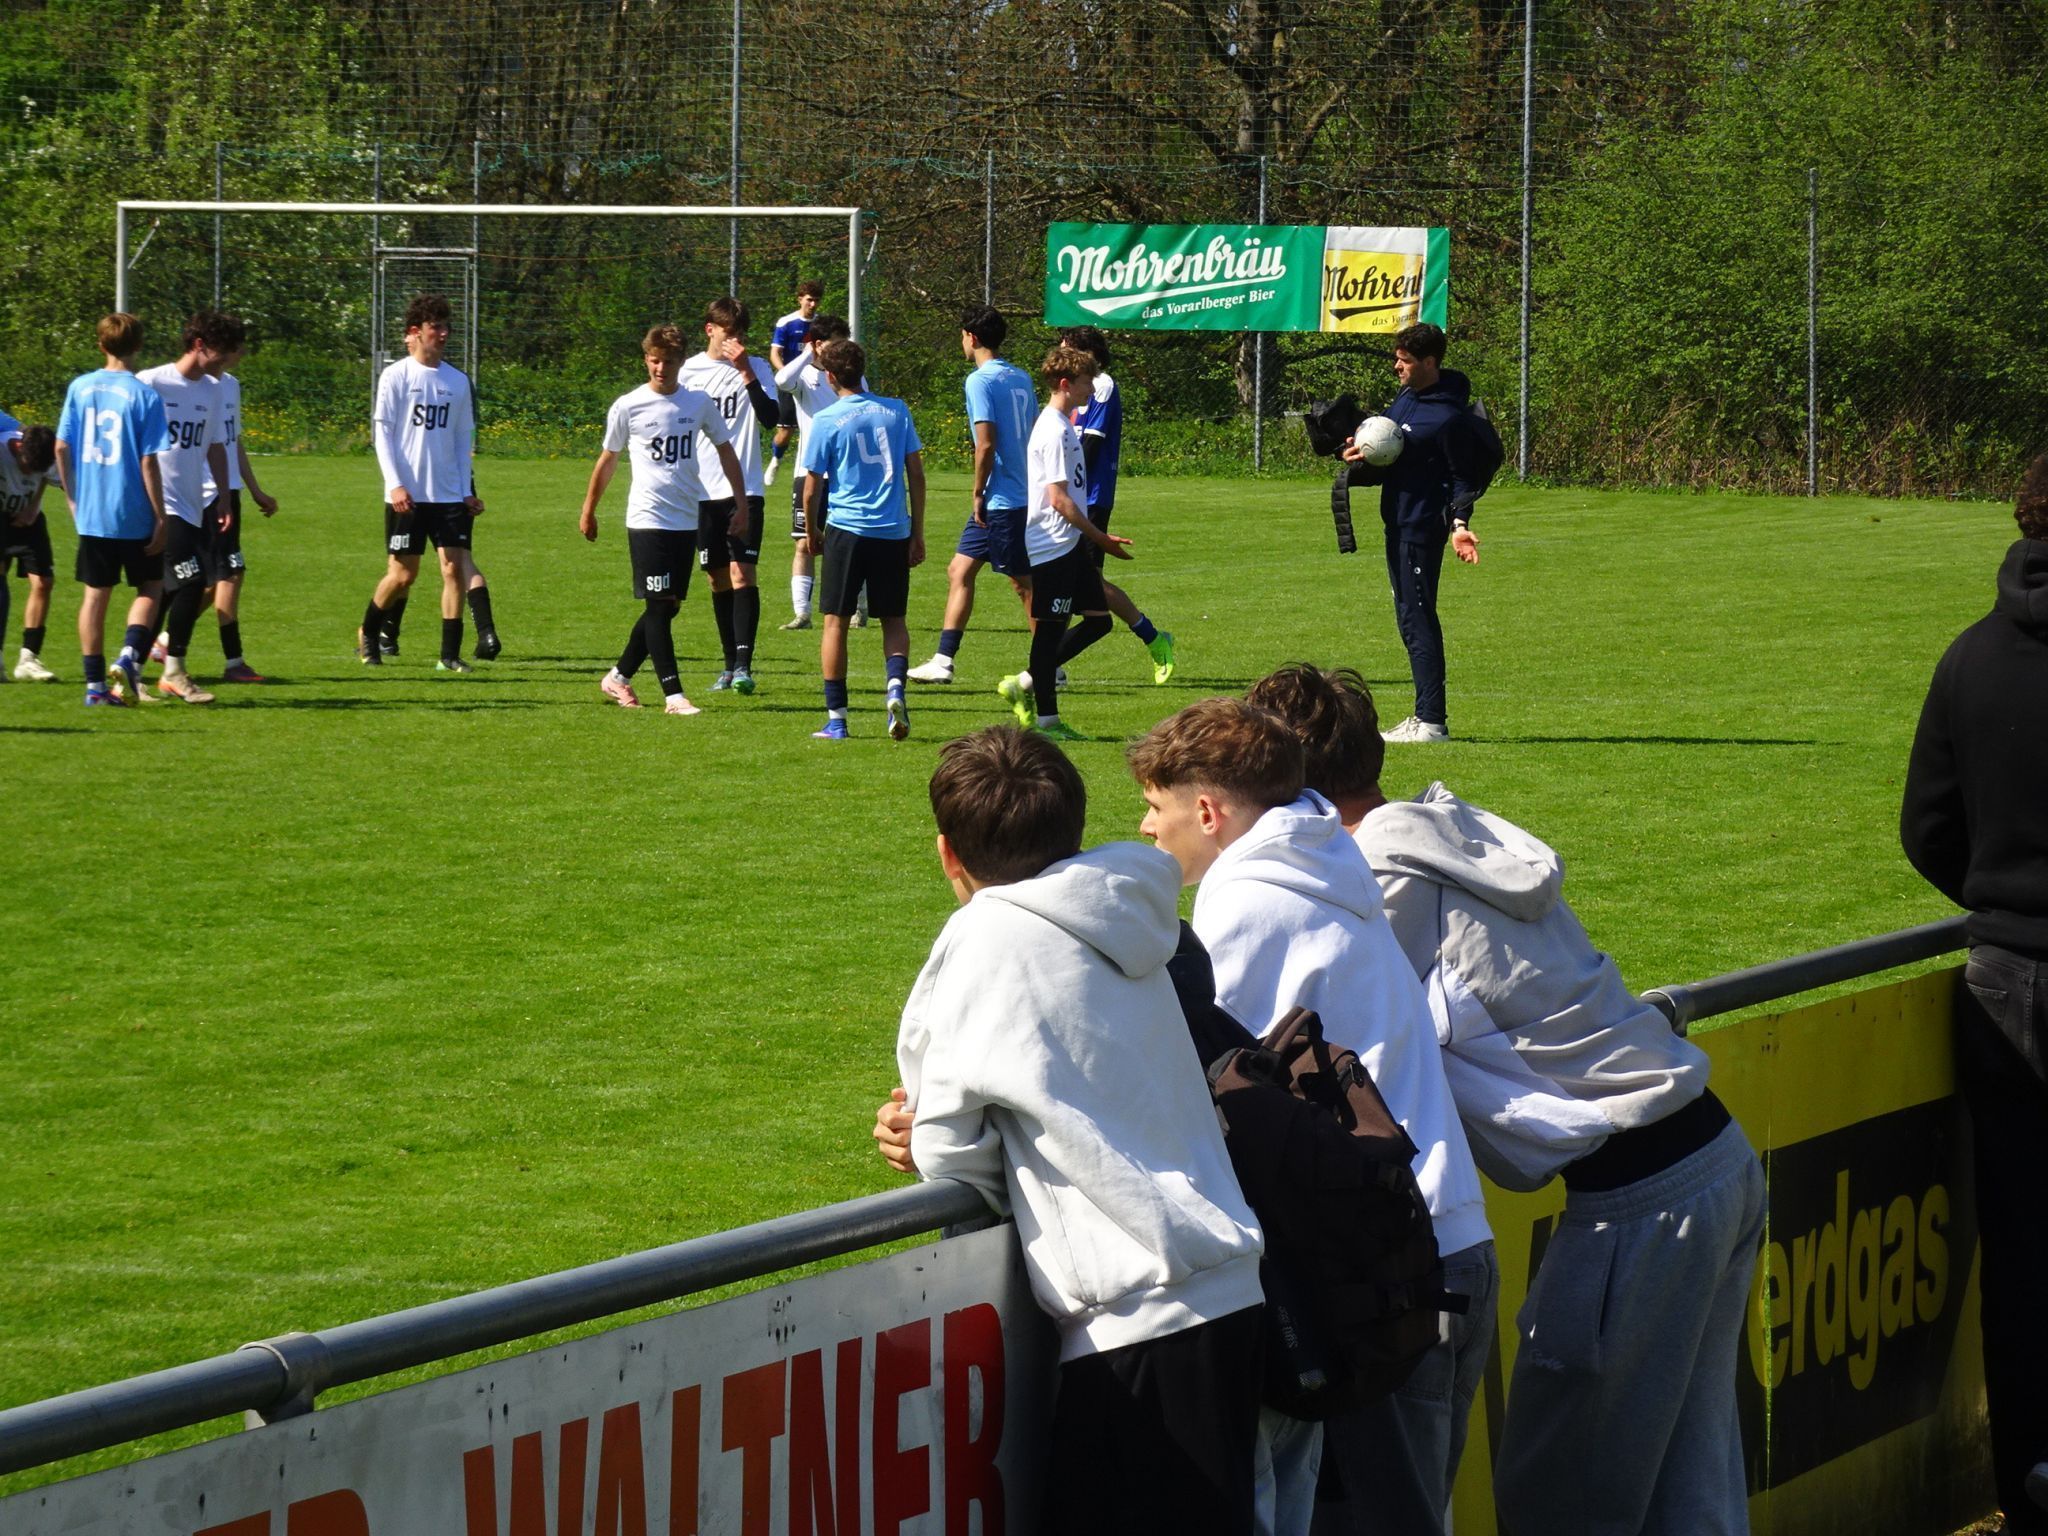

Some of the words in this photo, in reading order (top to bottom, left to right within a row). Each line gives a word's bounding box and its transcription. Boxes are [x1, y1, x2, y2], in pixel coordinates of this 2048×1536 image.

[1057, 235, 1287, 293] Mohrenbräu
[1142, 307, 1163, 319] das
[1167, 294, 1246, 315] Vorarlberger
[1249, 289, 1276, 303] Bier
[413, 402, 451, 430] sgd
[82, 407, 122, 466] 13
[168, 419, 206, 449] sgd
[651, 430, 693, 464] sgd
[856, 427, 893, 484] 4
[646, 572, 670, 592] sgd
[1747, 1169, 1950, 1391] erdgas
